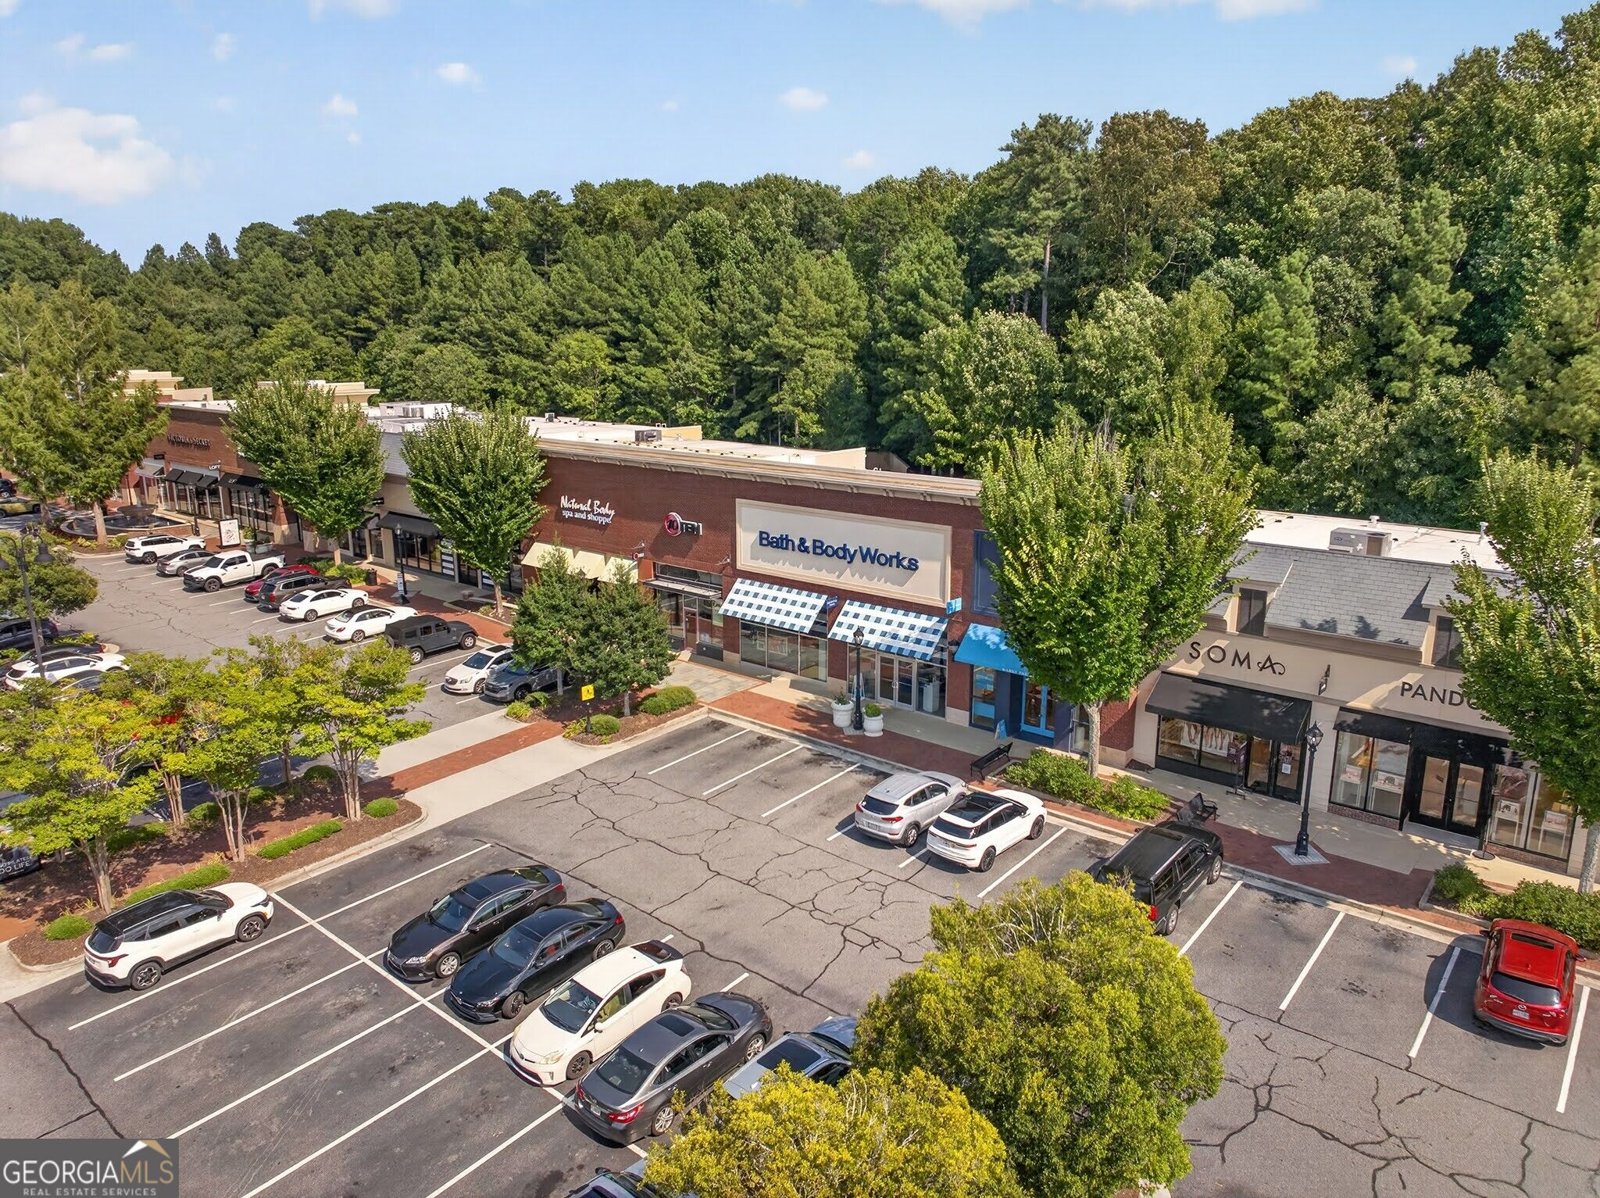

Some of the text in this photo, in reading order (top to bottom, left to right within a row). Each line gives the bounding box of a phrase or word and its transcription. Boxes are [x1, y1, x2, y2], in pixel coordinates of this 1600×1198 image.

[560, 495, 616, 521] Natural Body
[562, 510, 574, 518] spa
[574, 511, 587, 520] and
[758, 530, 920, 572] Bath & Body Works
[1188, 641, 1286, 676] SOMA
[13, 860, 31, 870] LIFE
